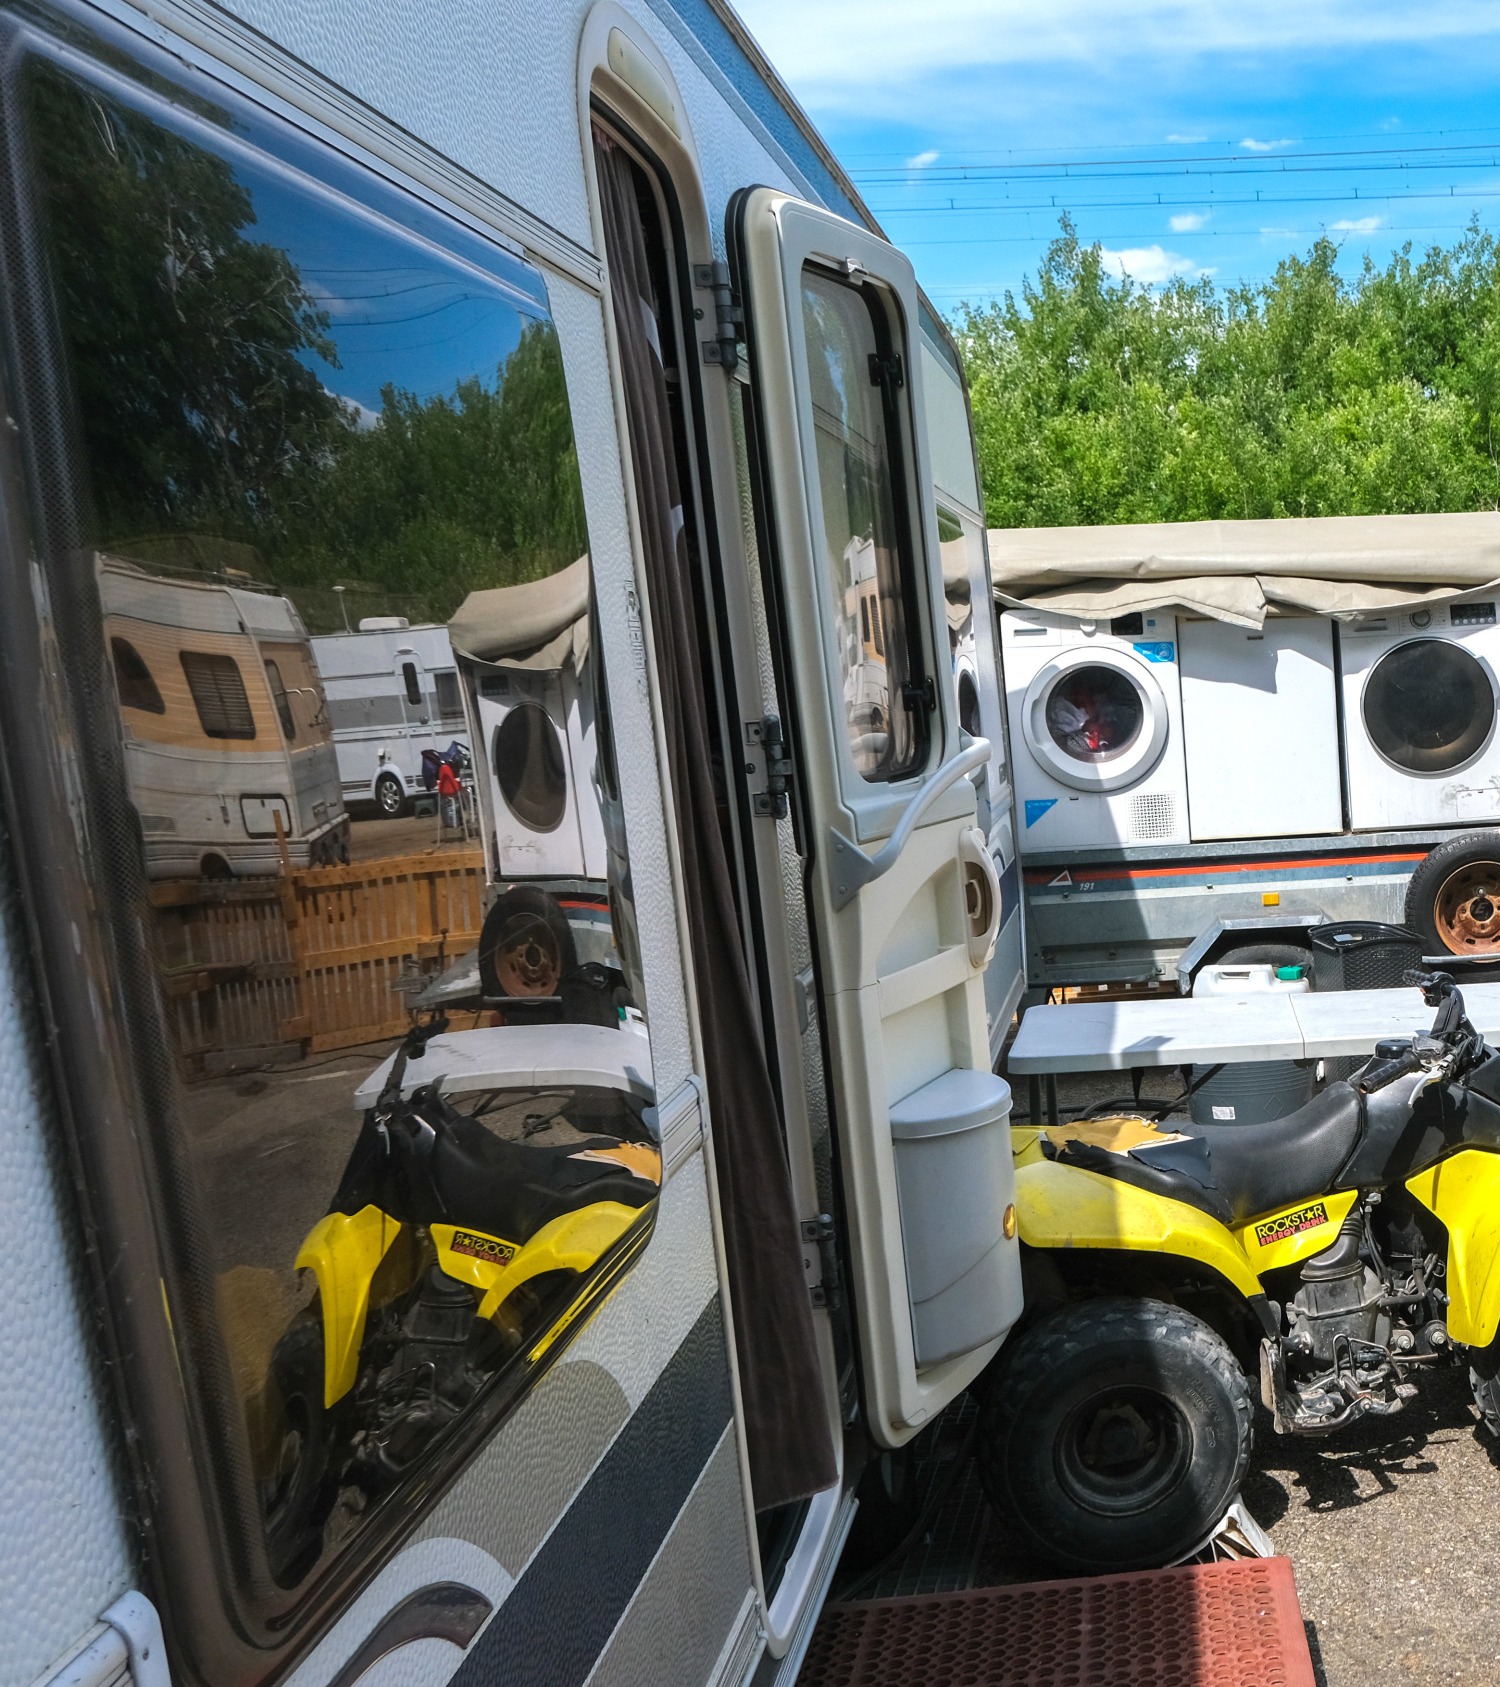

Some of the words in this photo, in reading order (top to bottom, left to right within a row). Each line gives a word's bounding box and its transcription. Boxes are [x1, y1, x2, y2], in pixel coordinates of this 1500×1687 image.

[1079, 882, 1095, 891] 191
[1260, 1225, 1296, 1246] ENERGY
[1299, 1214, 1326, 1231] DRINK
